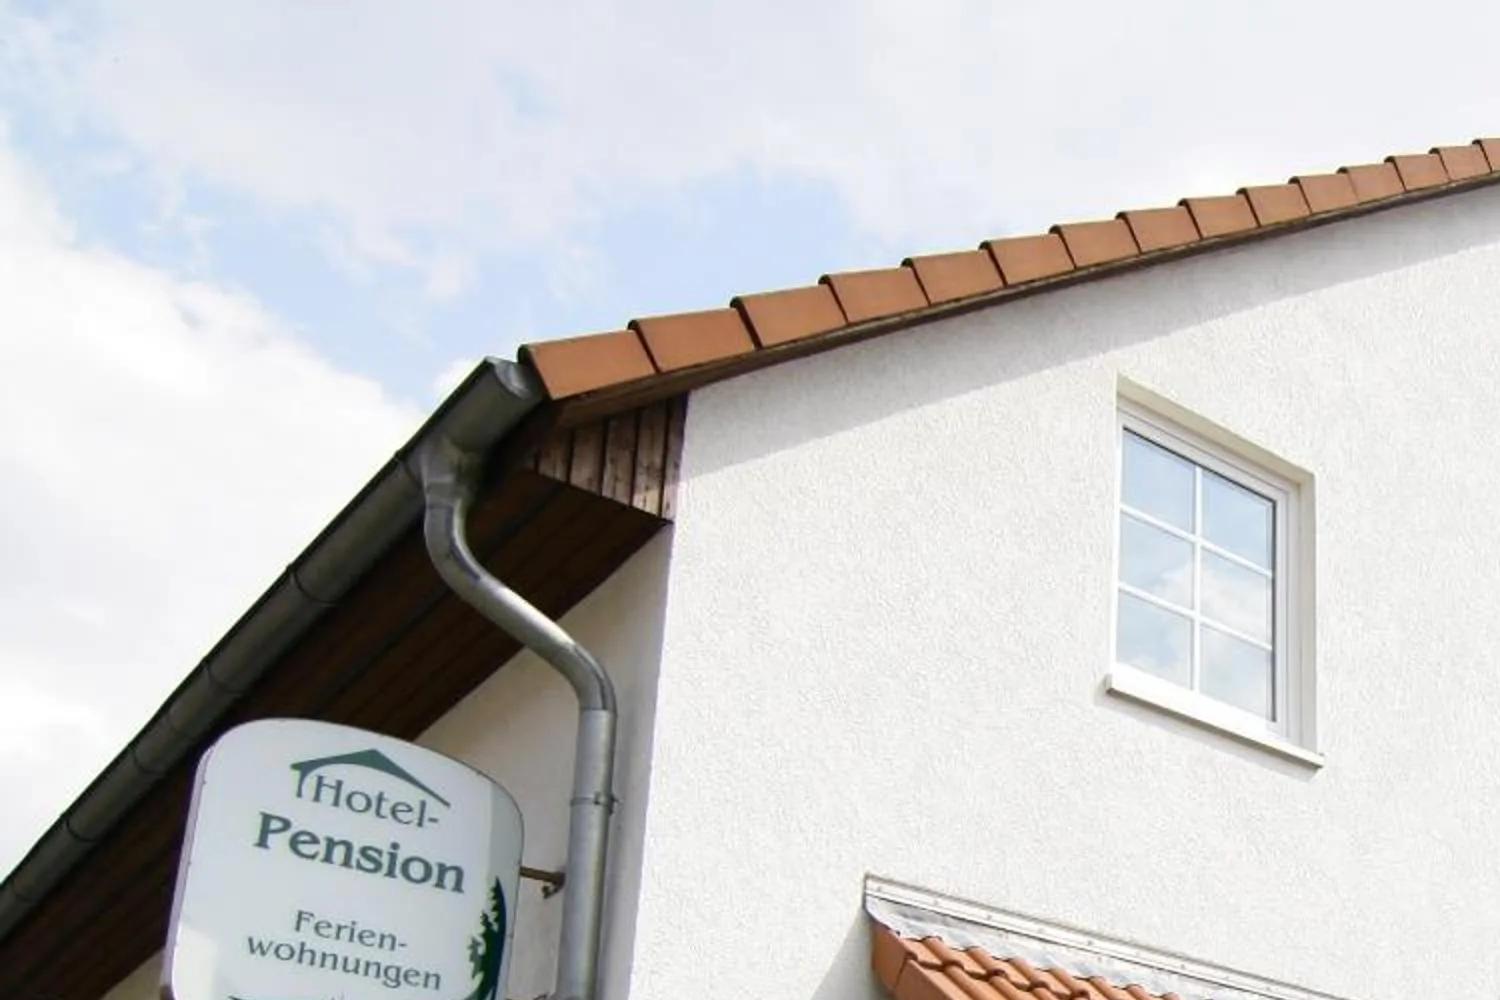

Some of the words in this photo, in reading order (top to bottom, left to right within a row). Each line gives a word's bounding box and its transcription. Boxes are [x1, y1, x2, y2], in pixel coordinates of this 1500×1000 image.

[311, 775, 440, 828] Hotel-
[252, 811, 467, 894] Pension
[294, 910, 408, 952] Ferien-
[246, 936, 443, 991] wohnungen
